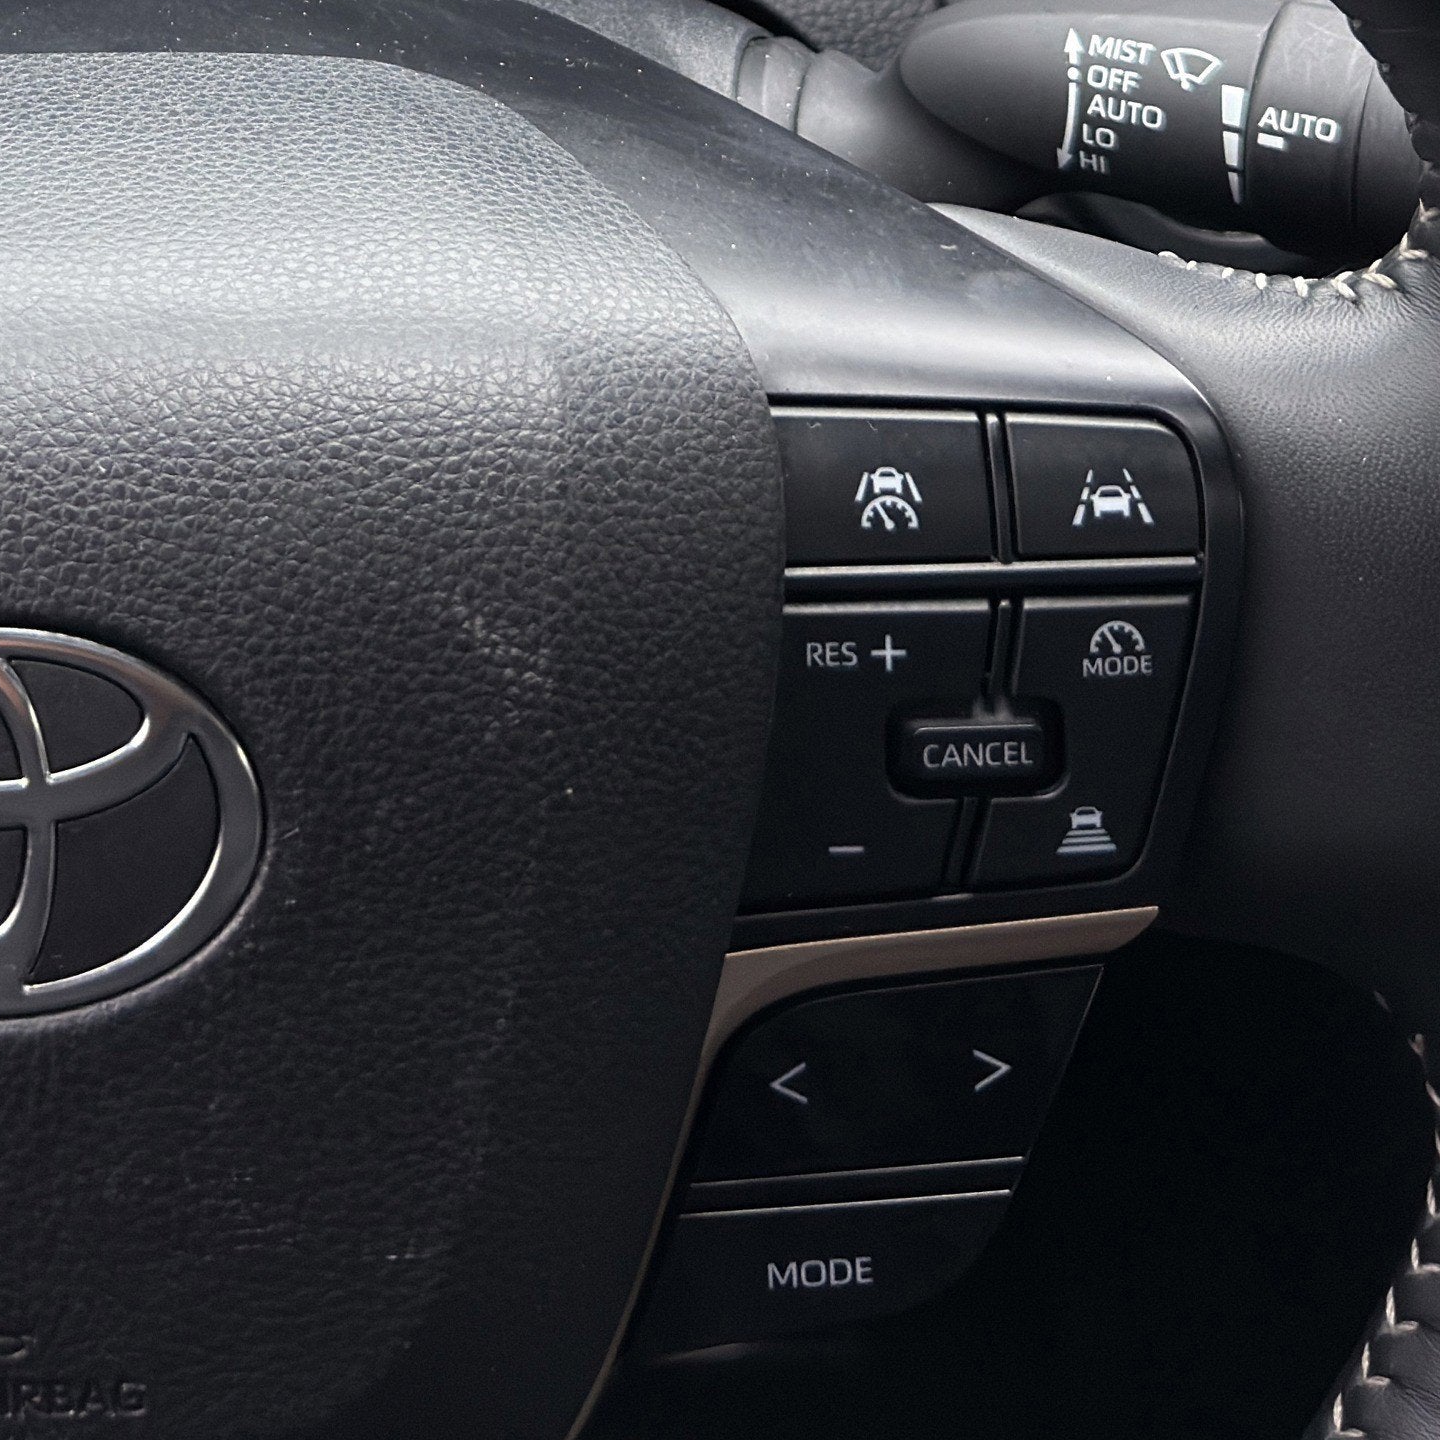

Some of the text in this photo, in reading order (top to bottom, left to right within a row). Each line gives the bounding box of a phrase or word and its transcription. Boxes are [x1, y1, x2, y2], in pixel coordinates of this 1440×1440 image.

[1087, 33, 1156, 65] MIST
[1086, 68, 1142, 93] OFF
[1086, 93, 1164, 130] AUTO
[1257, 105, 1342, 144] AUTO
[1081, 123, 1118, 150] LO
[1080, 149, 1112, 175] HI
[805, 642, 858, 668] RES
[1082, 654, 1153, 677] MODE
[922, 742, 1035, 769] CANCEL
[767, 1256, 874, 1290] MODE
